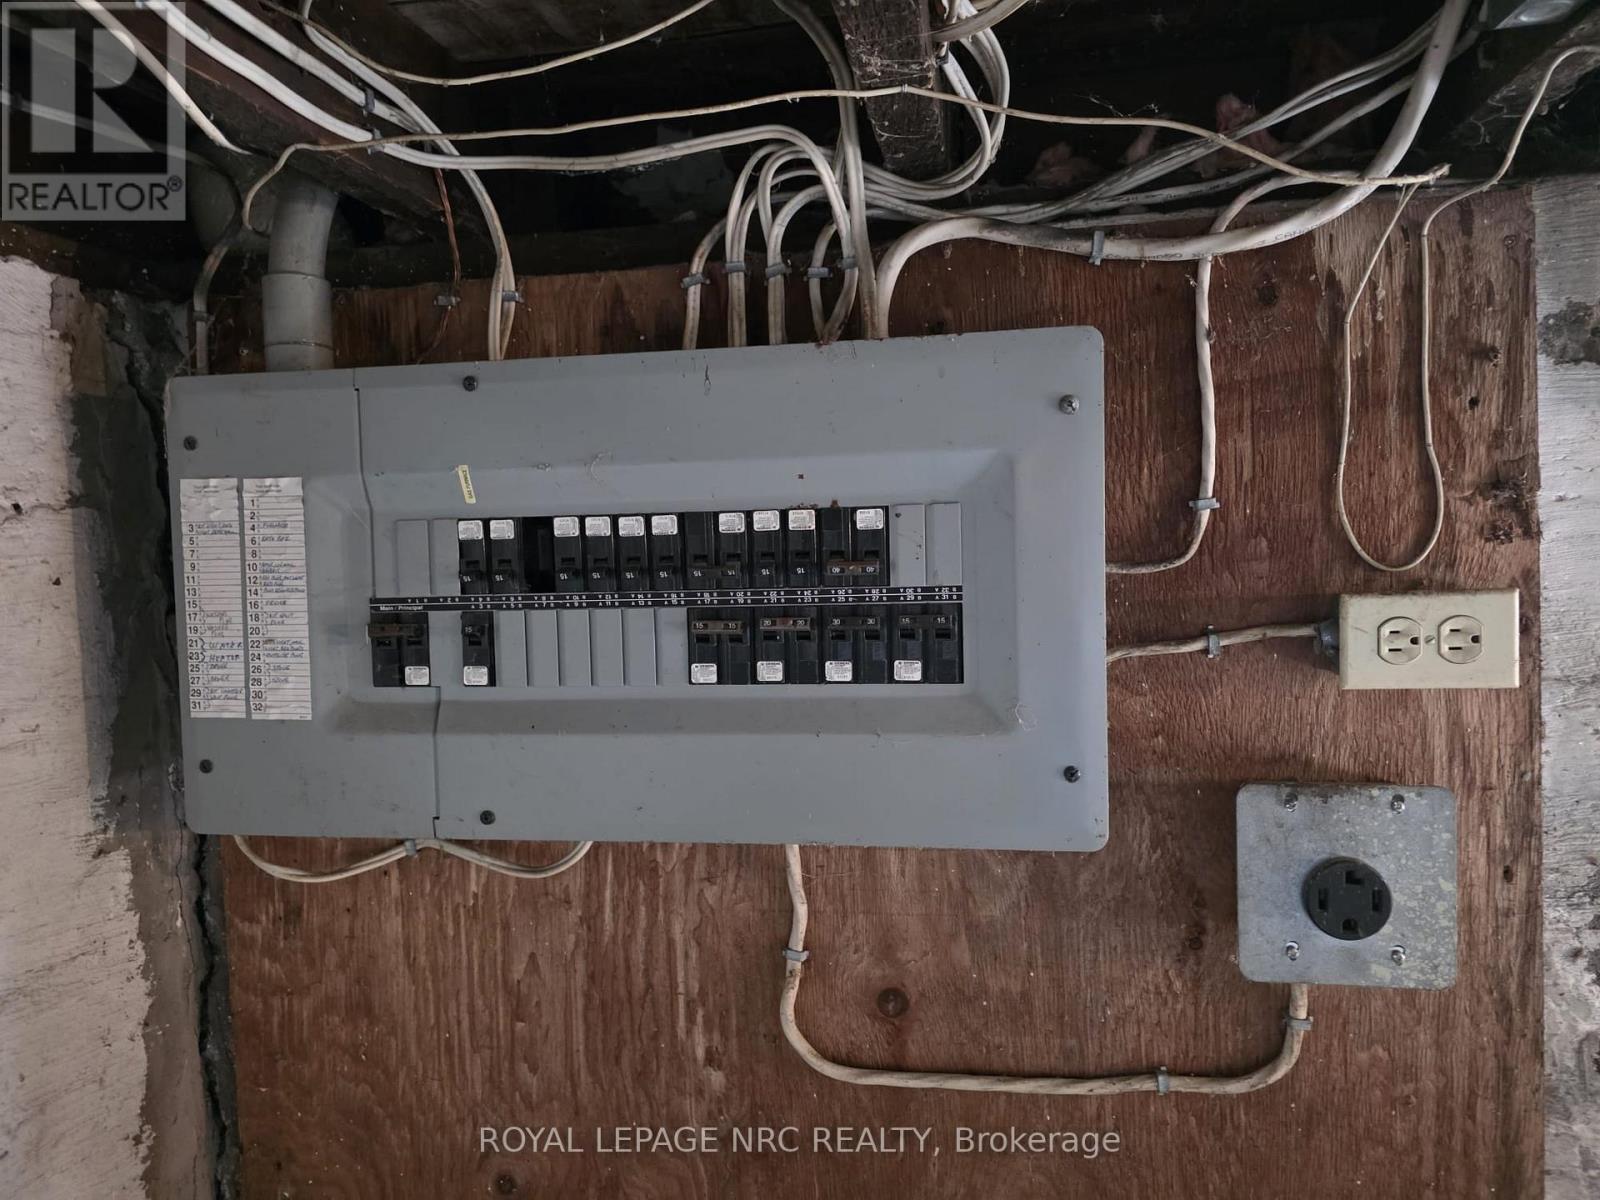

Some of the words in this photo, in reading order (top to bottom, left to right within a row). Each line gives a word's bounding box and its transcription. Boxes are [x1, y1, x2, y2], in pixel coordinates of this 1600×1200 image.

[250, 499, 255, 507] 1
[250, 511, 256, 520] 2
[188, 524, 194, 532] 3
[250, 524, 255, 532] 4
[189, 536, 194, 545] 5
[251, 536, 257, 545] 6
[189, 549, 195, 558] 7
[251, 549, 257, 558] 8
[190, 562, 196, 571] 9
[247, 562, 258, 571] 10
[186, 575, 195, 584] 11
[248, 575, 258, 585] 12
[186, 587, 197, 596] 13
[248, 588, 258, 597] 14
[187, 600, 198, 608] 15
[249, 601, 259, 610] 16
[188, 612, 198, 622] 17
[249, 613, 260, 622] 18
[188, 626, 198, 634] 19
[249, 627, 260, 636] 20
[189, 639, 198, 648] 21
[250, 640, 261, 649] 22
[189, 651, 199, 660] 23
[250, 653, 261, 662] 24
[190, 664, 200, 673] 25
[251, 665, 262, 674] 26
[190, 676, 200, 685] 27
[251, 678, 262, 687] 28
[190, 689, 201, 697] 29
[251, 690, 263, 699] 30
[191, 701, 201, 710] 31
[252, 702, 263, 711] 32
